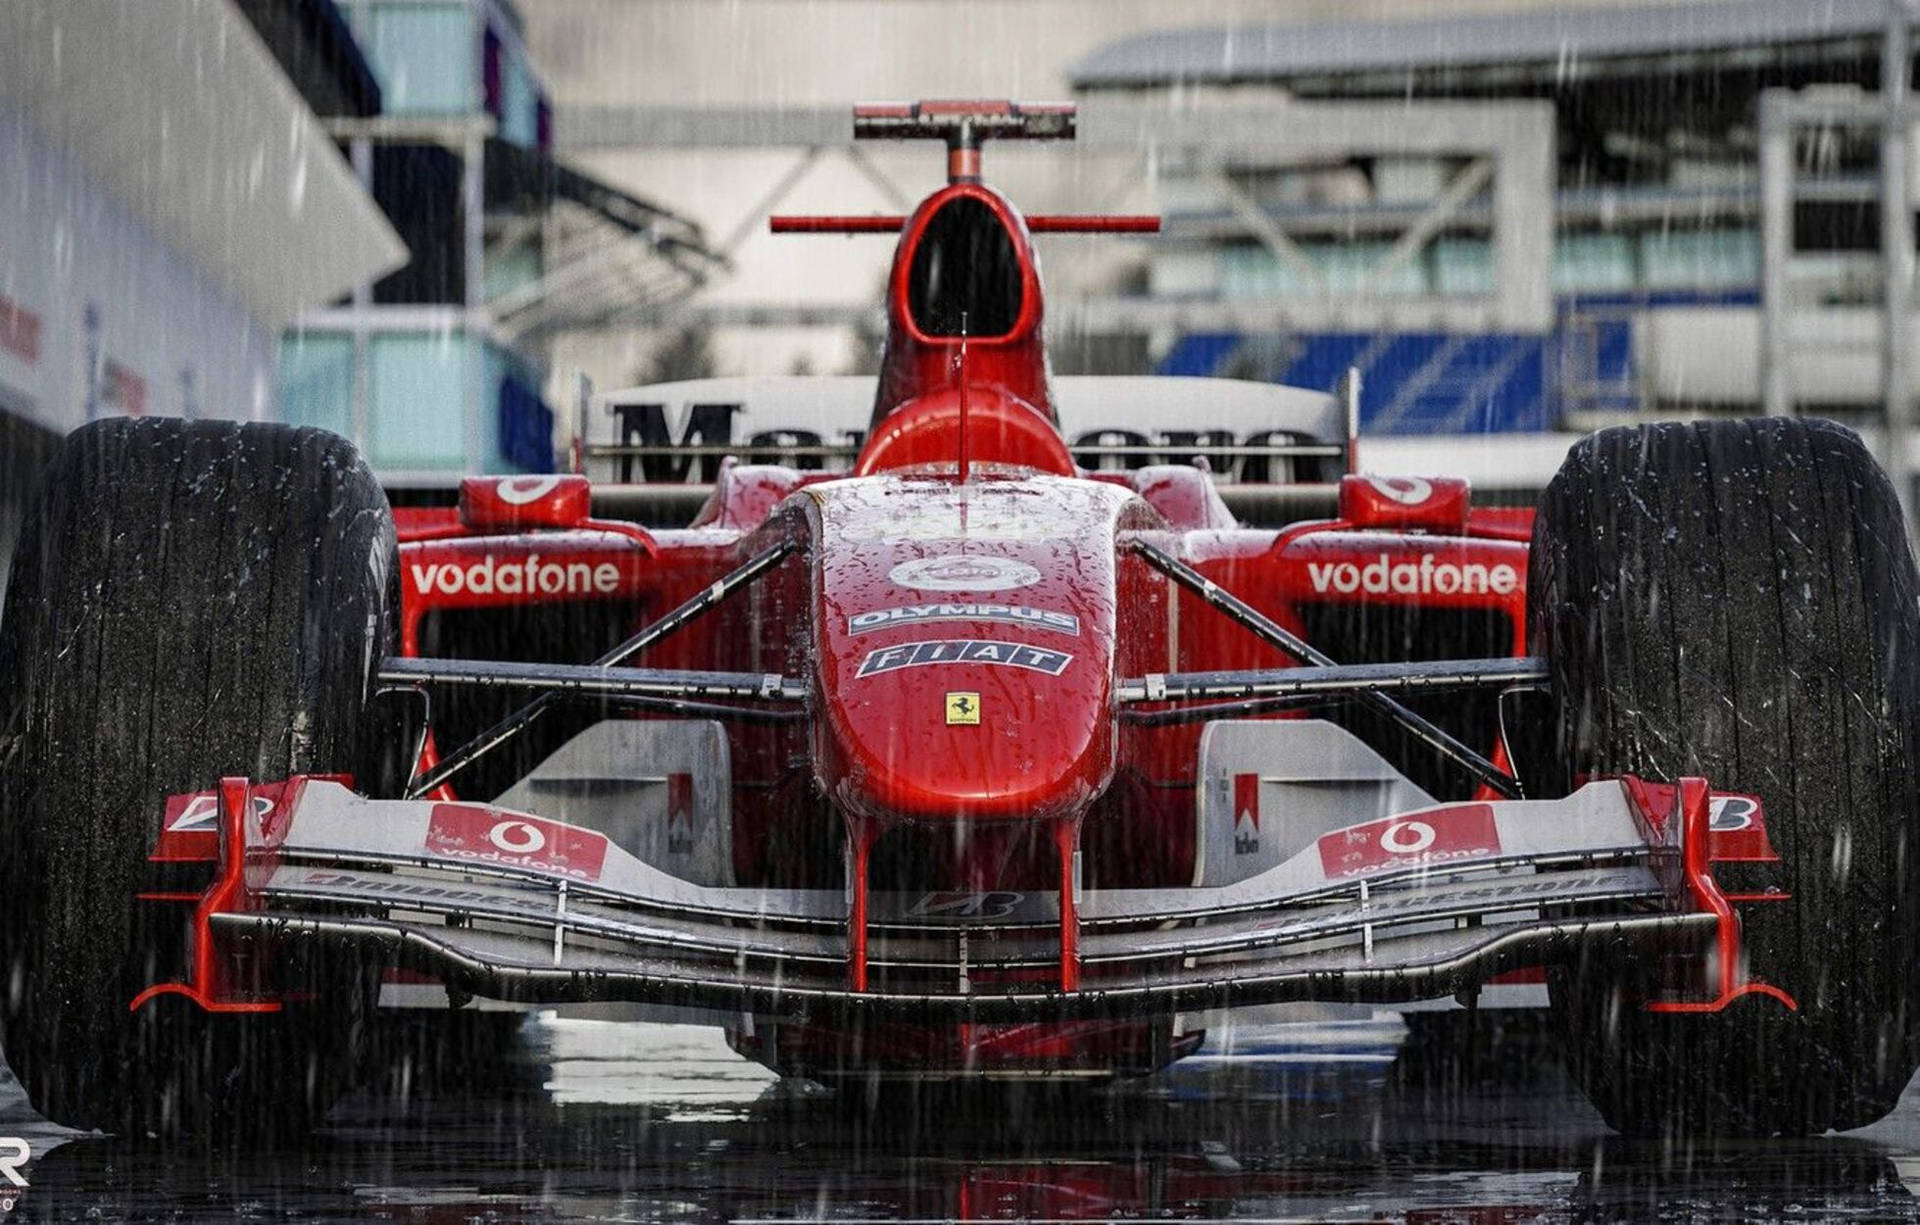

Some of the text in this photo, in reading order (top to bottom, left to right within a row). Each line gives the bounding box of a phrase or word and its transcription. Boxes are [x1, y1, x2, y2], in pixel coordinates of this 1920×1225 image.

[411, 554, 620, 595] vodafone
[1307, 553, 1518, 595] vodafone
[853, 603, 1076, 628] OLYMPUS
[876, 644, 1055, 670] FIAT
[441, 847, 589, 879] vodafone
[1342, 847, 1490, 877] vodafone
